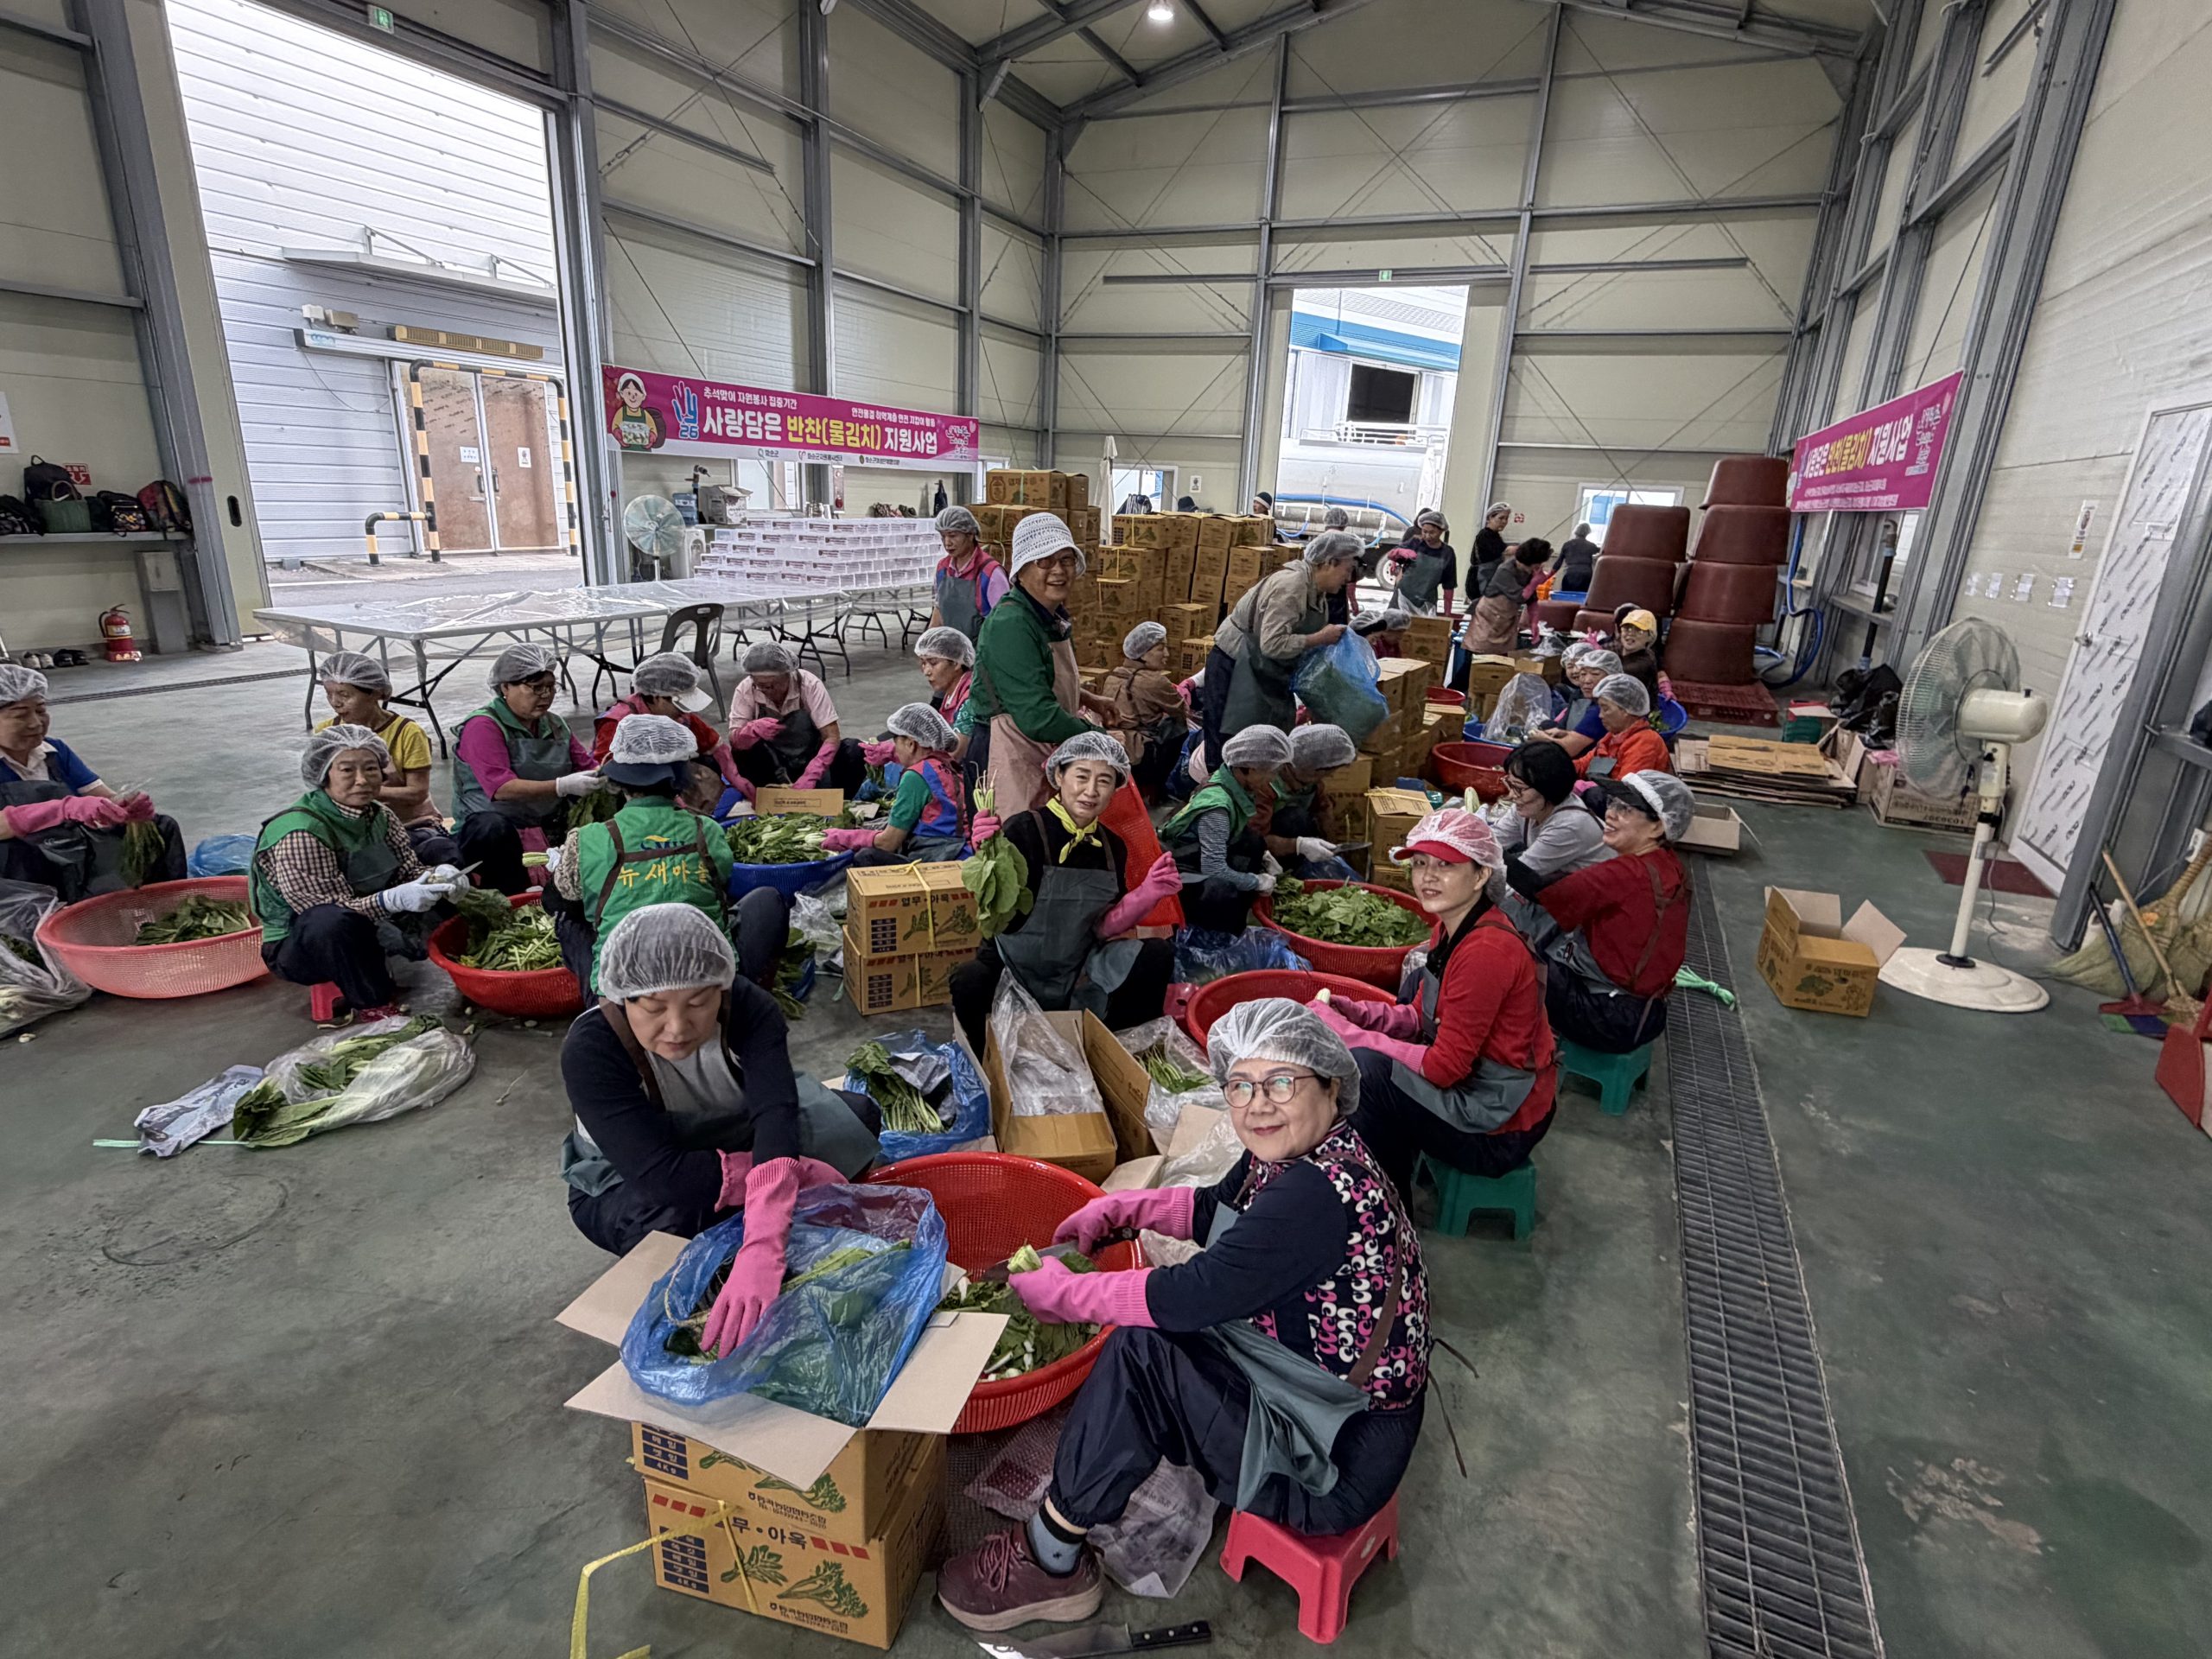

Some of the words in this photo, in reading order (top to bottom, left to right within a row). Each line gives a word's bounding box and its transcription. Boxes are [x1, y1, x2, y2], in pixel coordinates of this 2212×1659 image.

[703, 386, 736, 403] 추석맞이
[738, 391, 768, 406] 자원봉사
[769, 396, 798, 410] 집중기간
[703, 406, 782, 441] 사랑담은
[787, 415, 881, 451] 반찬(물김치)
[884, 427, 938, 454] 지원사업
[1867, 413, 1914, 467] 지원사업
